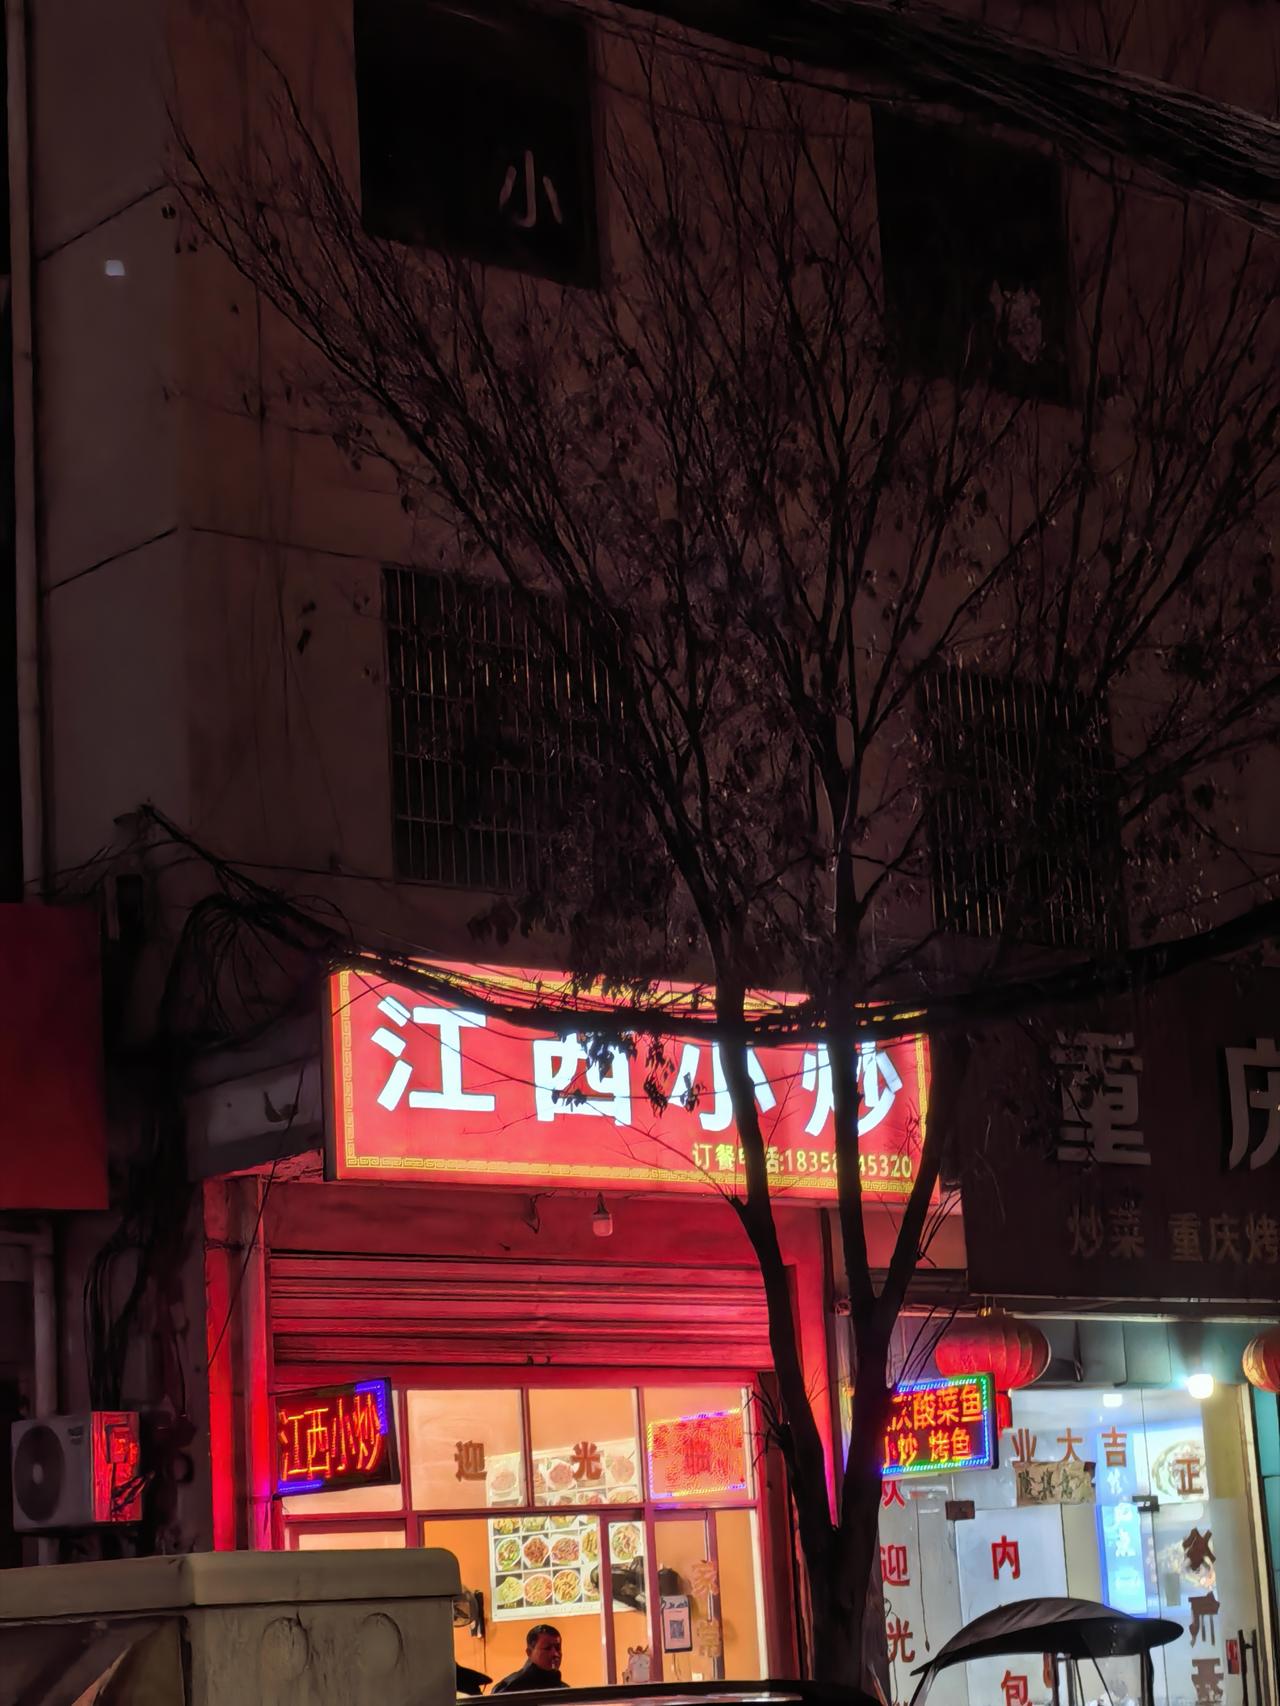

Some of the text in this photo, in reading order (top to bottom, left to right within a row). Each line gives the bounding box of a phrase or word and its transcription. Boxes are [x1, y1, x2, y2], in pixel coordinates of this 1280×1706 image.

[498, 149, 563, 229] 小
[370, 995, 903, 1138] 江西小炒
[279, 1394, 381, 1481] 江西小炒
